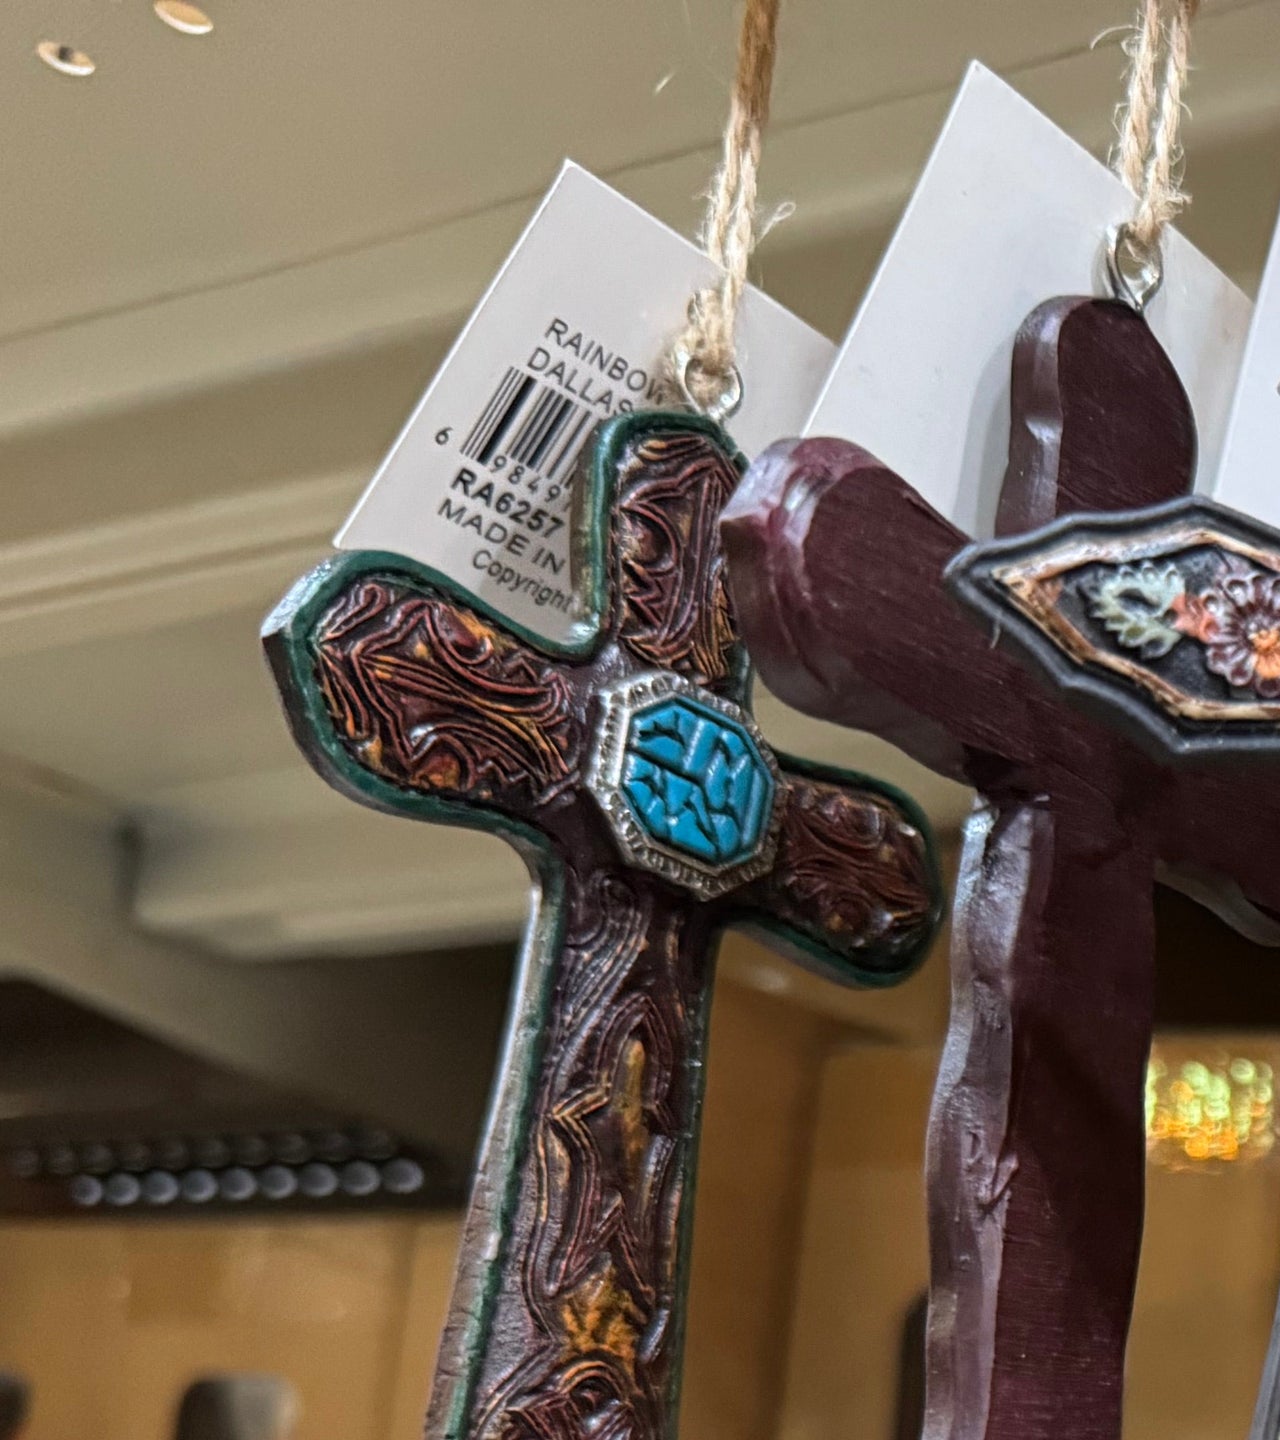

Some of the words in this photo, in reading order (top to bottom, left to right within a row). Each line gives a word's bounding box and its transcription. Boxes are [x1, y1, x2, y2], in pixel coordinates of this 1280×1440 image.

[437, 498, 531, 557] MADE
[532, 547, 566, 575] IN
[451, 467, 565, 539] RA6257
